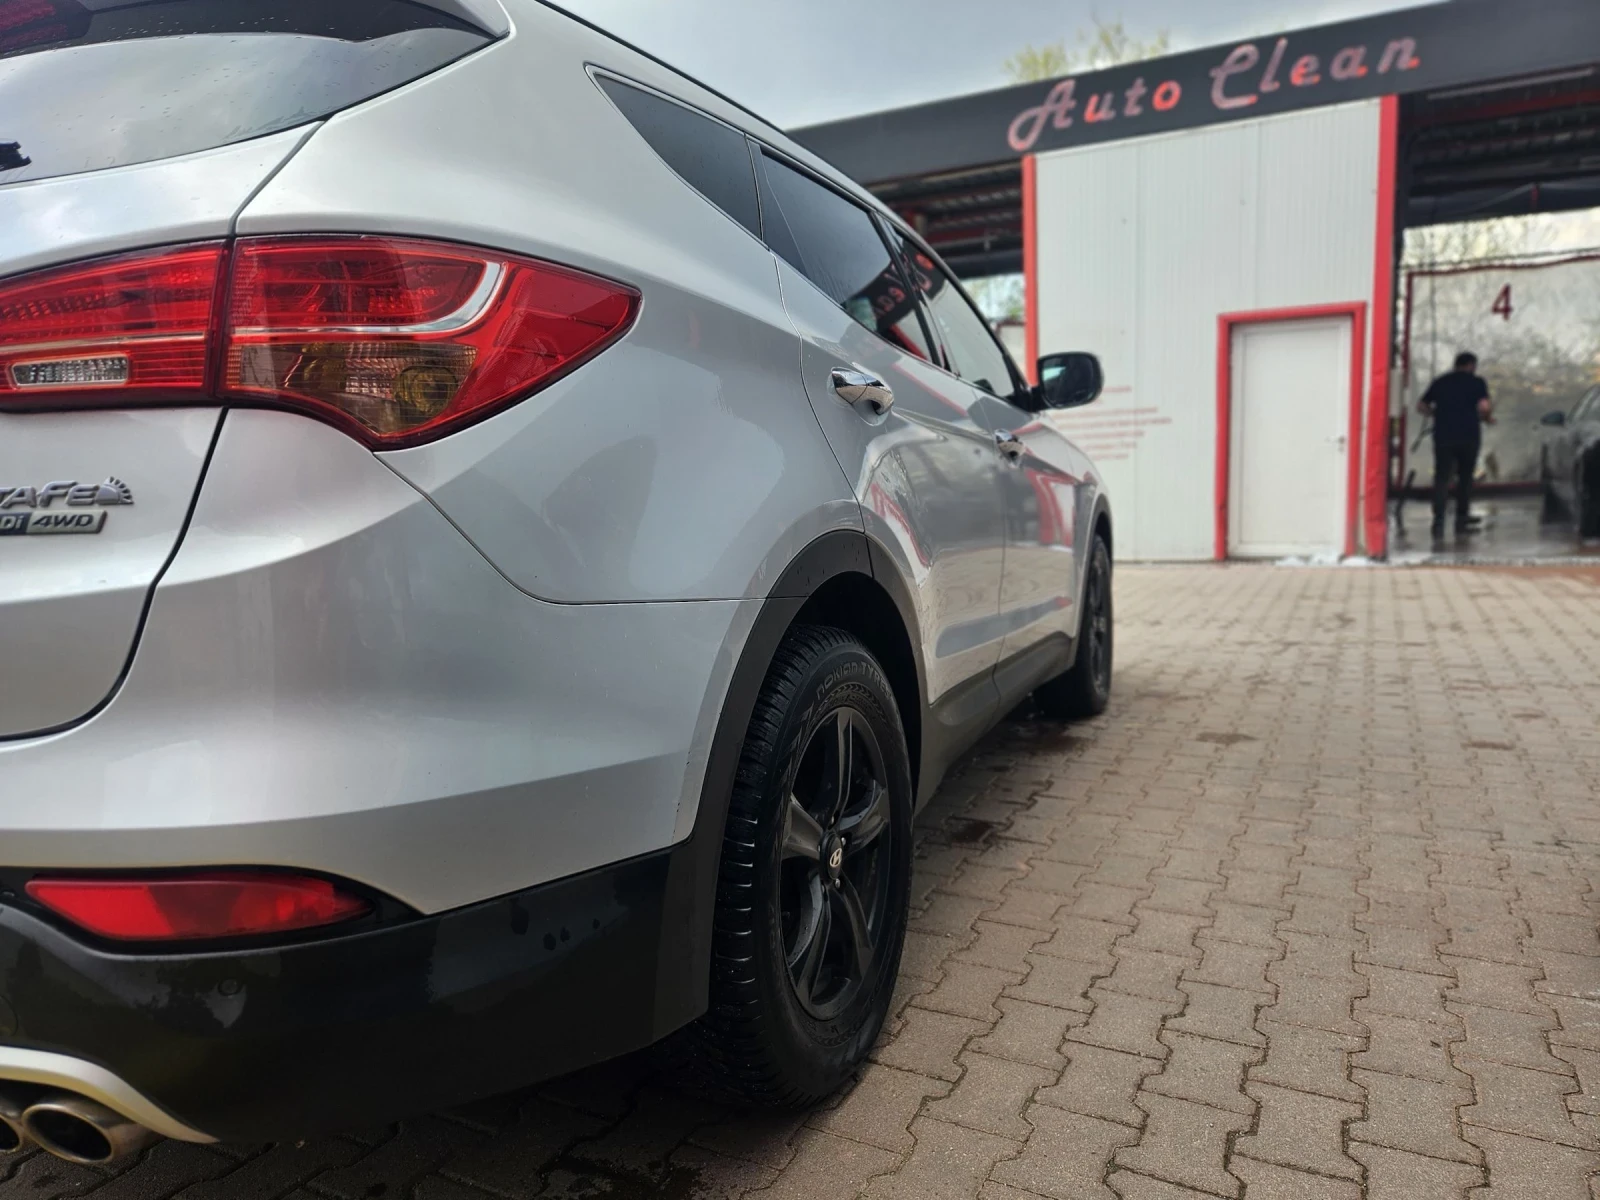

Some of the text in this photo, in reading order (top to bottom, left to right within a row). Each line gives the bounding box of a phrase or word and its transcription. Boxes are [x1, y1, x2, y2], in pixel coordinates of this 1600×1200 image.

[1007, 36, 1420, 151] Auto Clean
[1491, 283, 1514, 321] 4
[32, 514, 95, 528] 4WD
